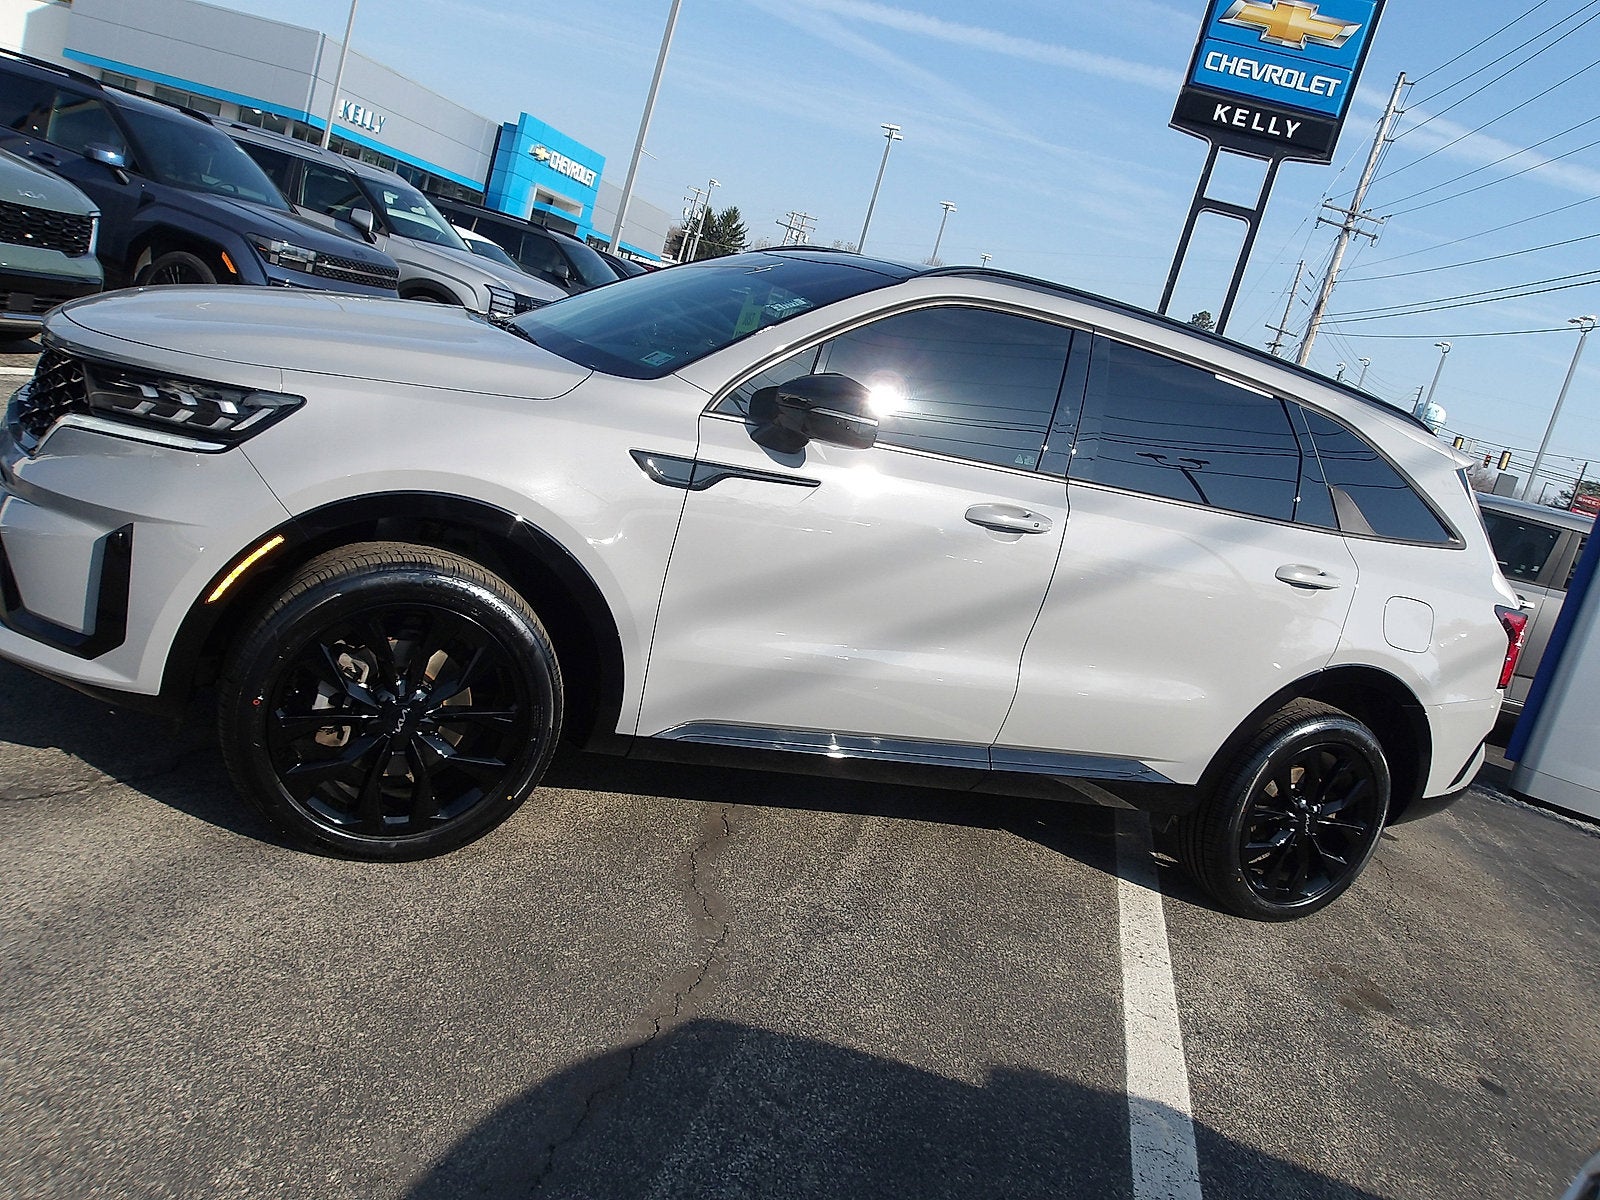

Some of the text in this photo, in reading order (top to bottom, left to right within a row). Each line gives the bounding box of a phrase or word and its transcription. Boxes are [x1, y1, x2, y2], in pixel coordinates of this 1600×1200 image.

[1204, 51, 1342, 97] CHEVROLET
[339, 99, 386, 134] KELLY
[1212, 103, 1301, 139] KELLY
[549, 150, 597, 188] CHEVROLET
